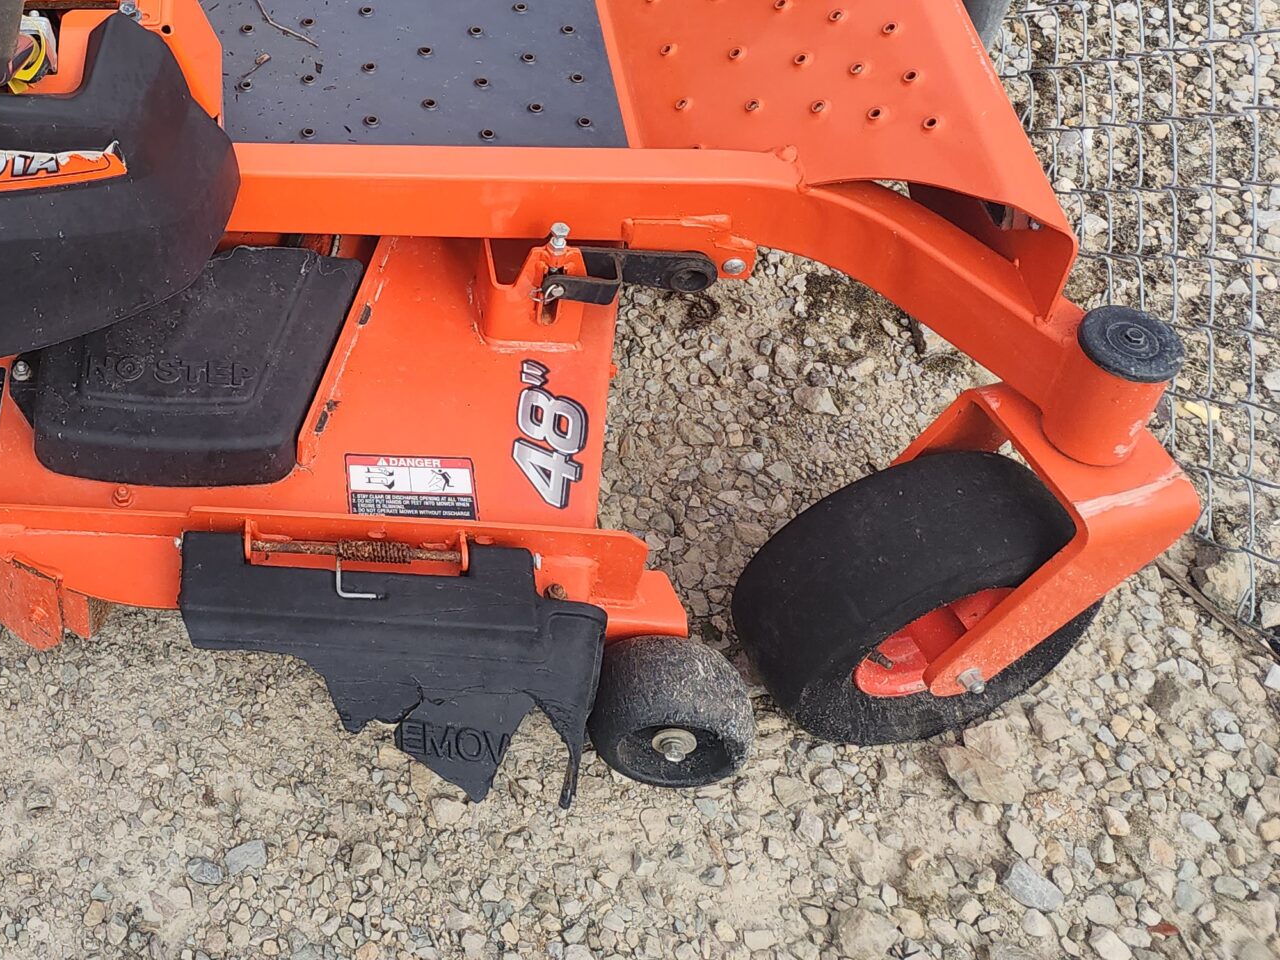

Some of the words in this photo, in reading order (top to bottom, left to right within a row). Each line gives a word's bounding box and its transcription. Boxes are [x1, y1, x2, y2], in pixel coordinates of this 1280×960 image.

[86, 354, 144, 383] NO
[153, 359, 257, 388] STEP
[389, 457, 441, 467] DANGER
